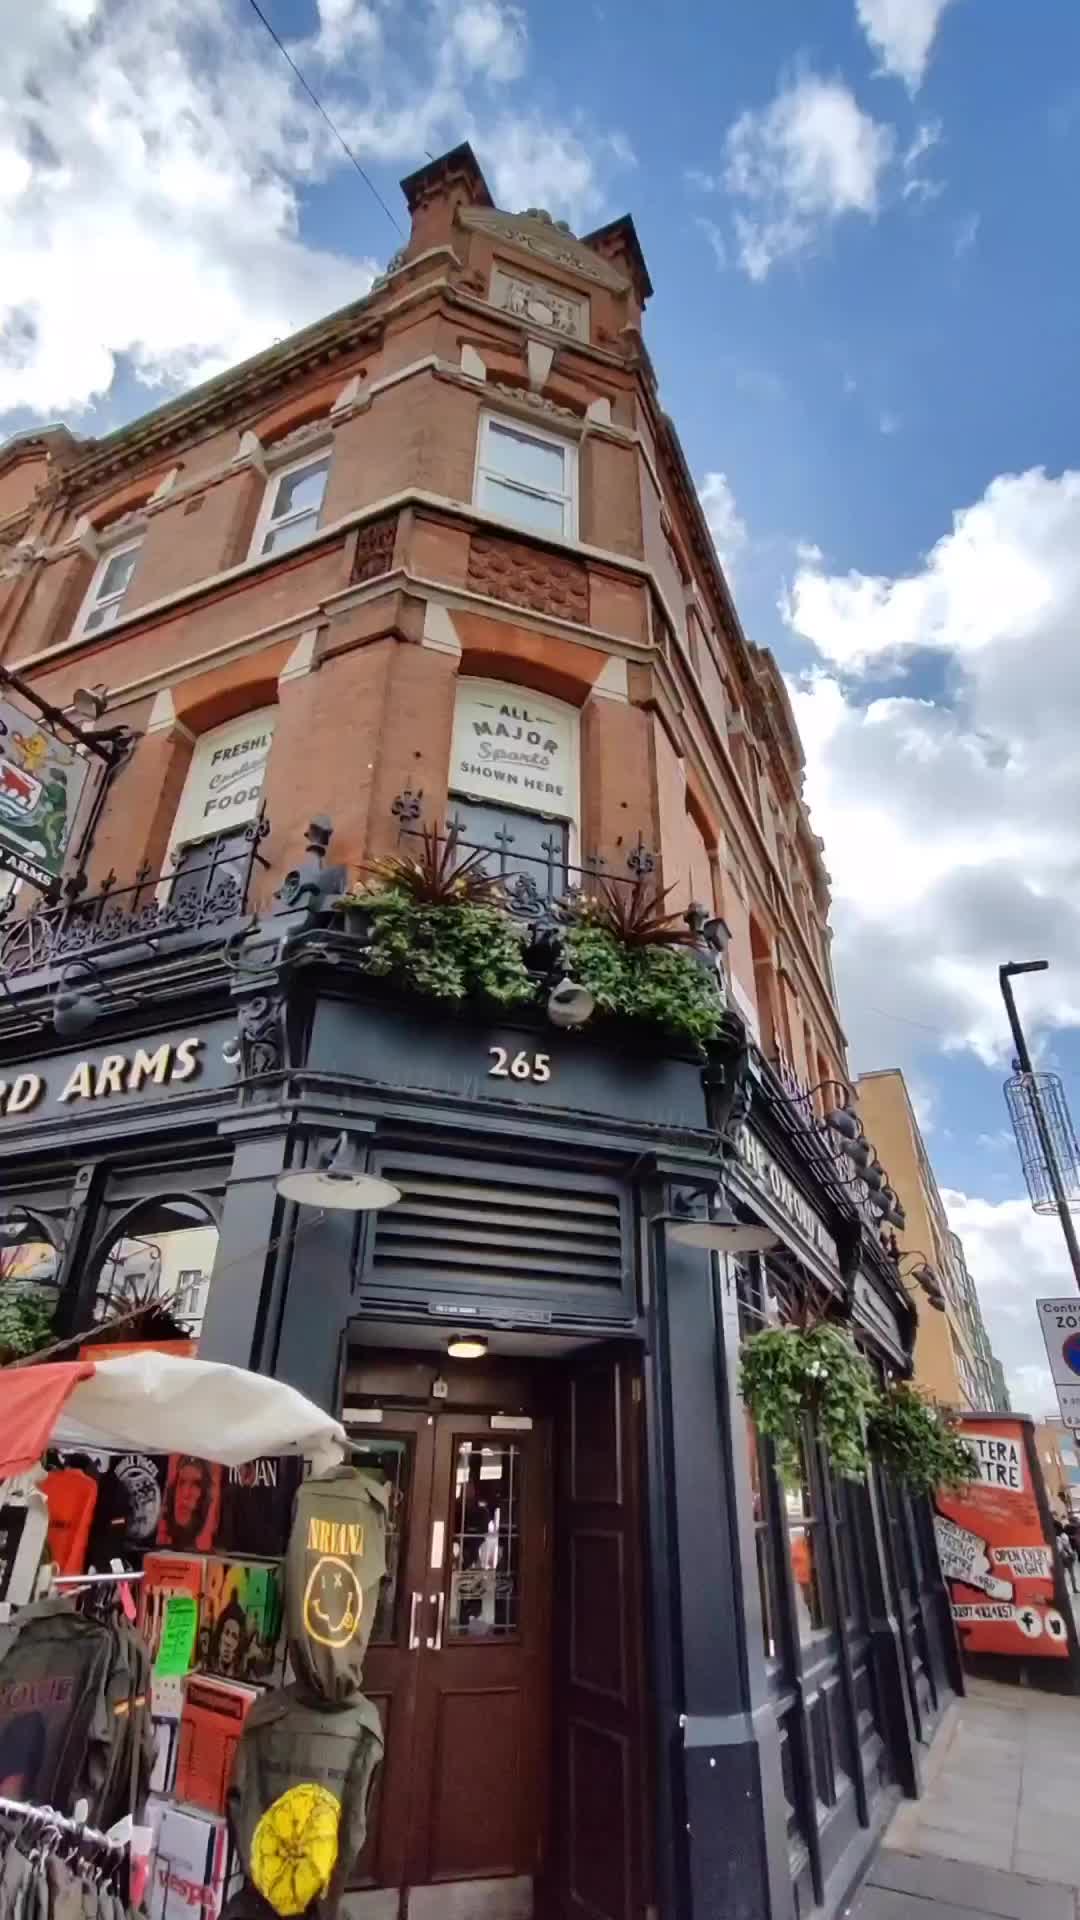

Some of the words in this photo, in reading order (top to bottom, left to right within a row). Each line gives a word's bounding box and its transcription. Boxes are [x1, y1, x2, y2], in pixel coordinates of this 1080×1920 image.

[500, 704, 534, 723] ALL
[210, 734, 273, 767] FRESHL
[472, 721, 559, 755] MAJOR
[477, 740, 551, 767] Sports
[460, 760, 519, 785] SHOWN
[523, 777, 564, 797] HERE
[203, 785, 262, 818] FOOD
[5, 855, 51, 886] ARMS
[57, 1037, 200, 1102] ARMS
[488, 1046, 551, 1082] 265
[1055, 1316, 1080, 1329] ZO
[971, 1439, 1019, 1465] TERA
[994, 1549, 1022, 1562] OPEN
[1013, 1561, 1046, 1576] NIGHT
